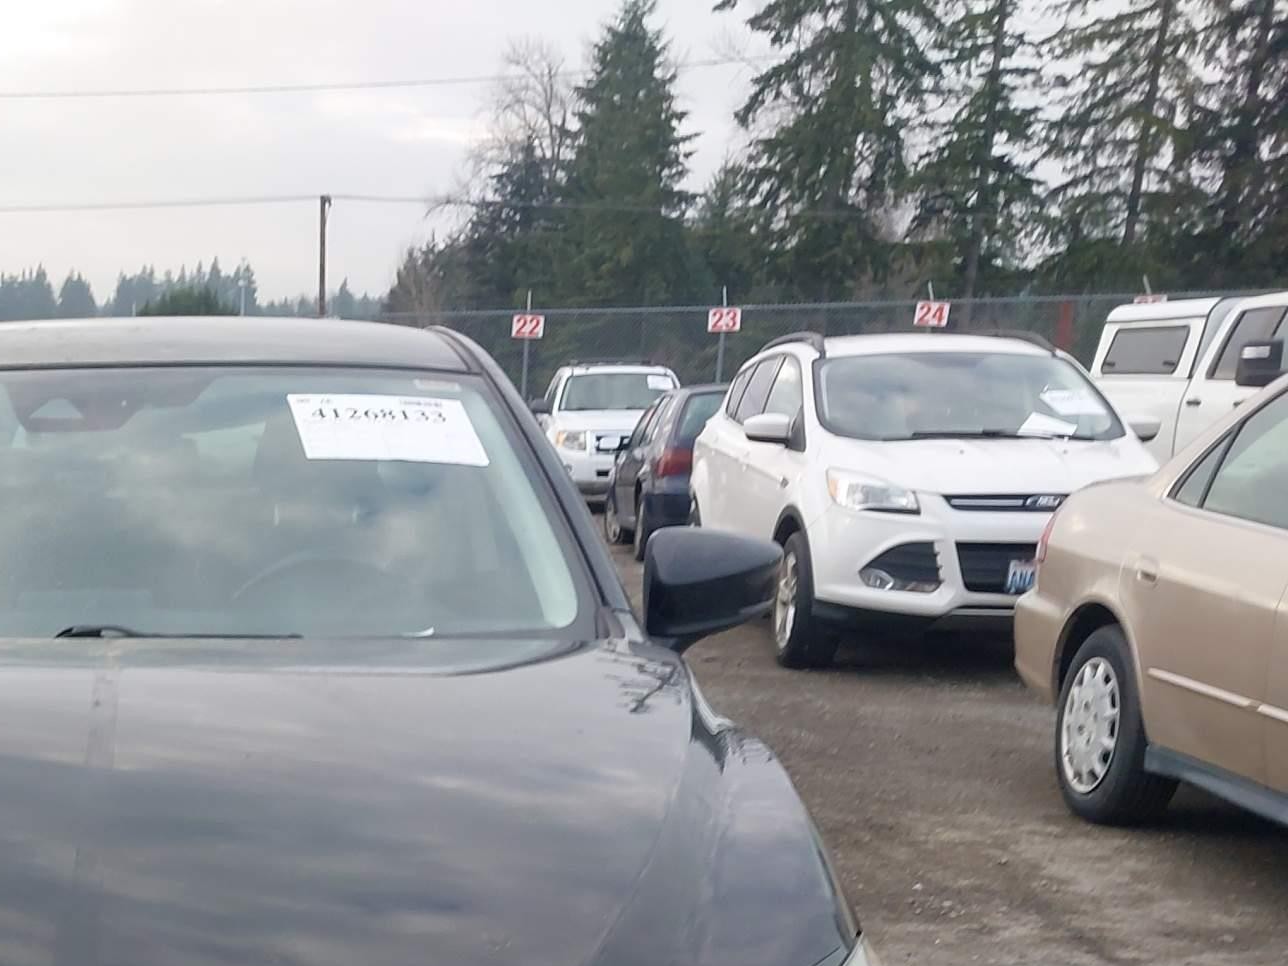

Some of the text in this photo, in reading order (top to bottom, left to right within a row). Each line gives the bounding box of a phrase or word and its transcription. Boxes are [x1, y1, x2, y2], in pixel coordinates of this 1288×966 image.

[711, 310, 737, 331] 23
[918, 303, 945, 325] 24
[515, 316, 541, 337] 22
[312, 407, 447, 423] 41268133
